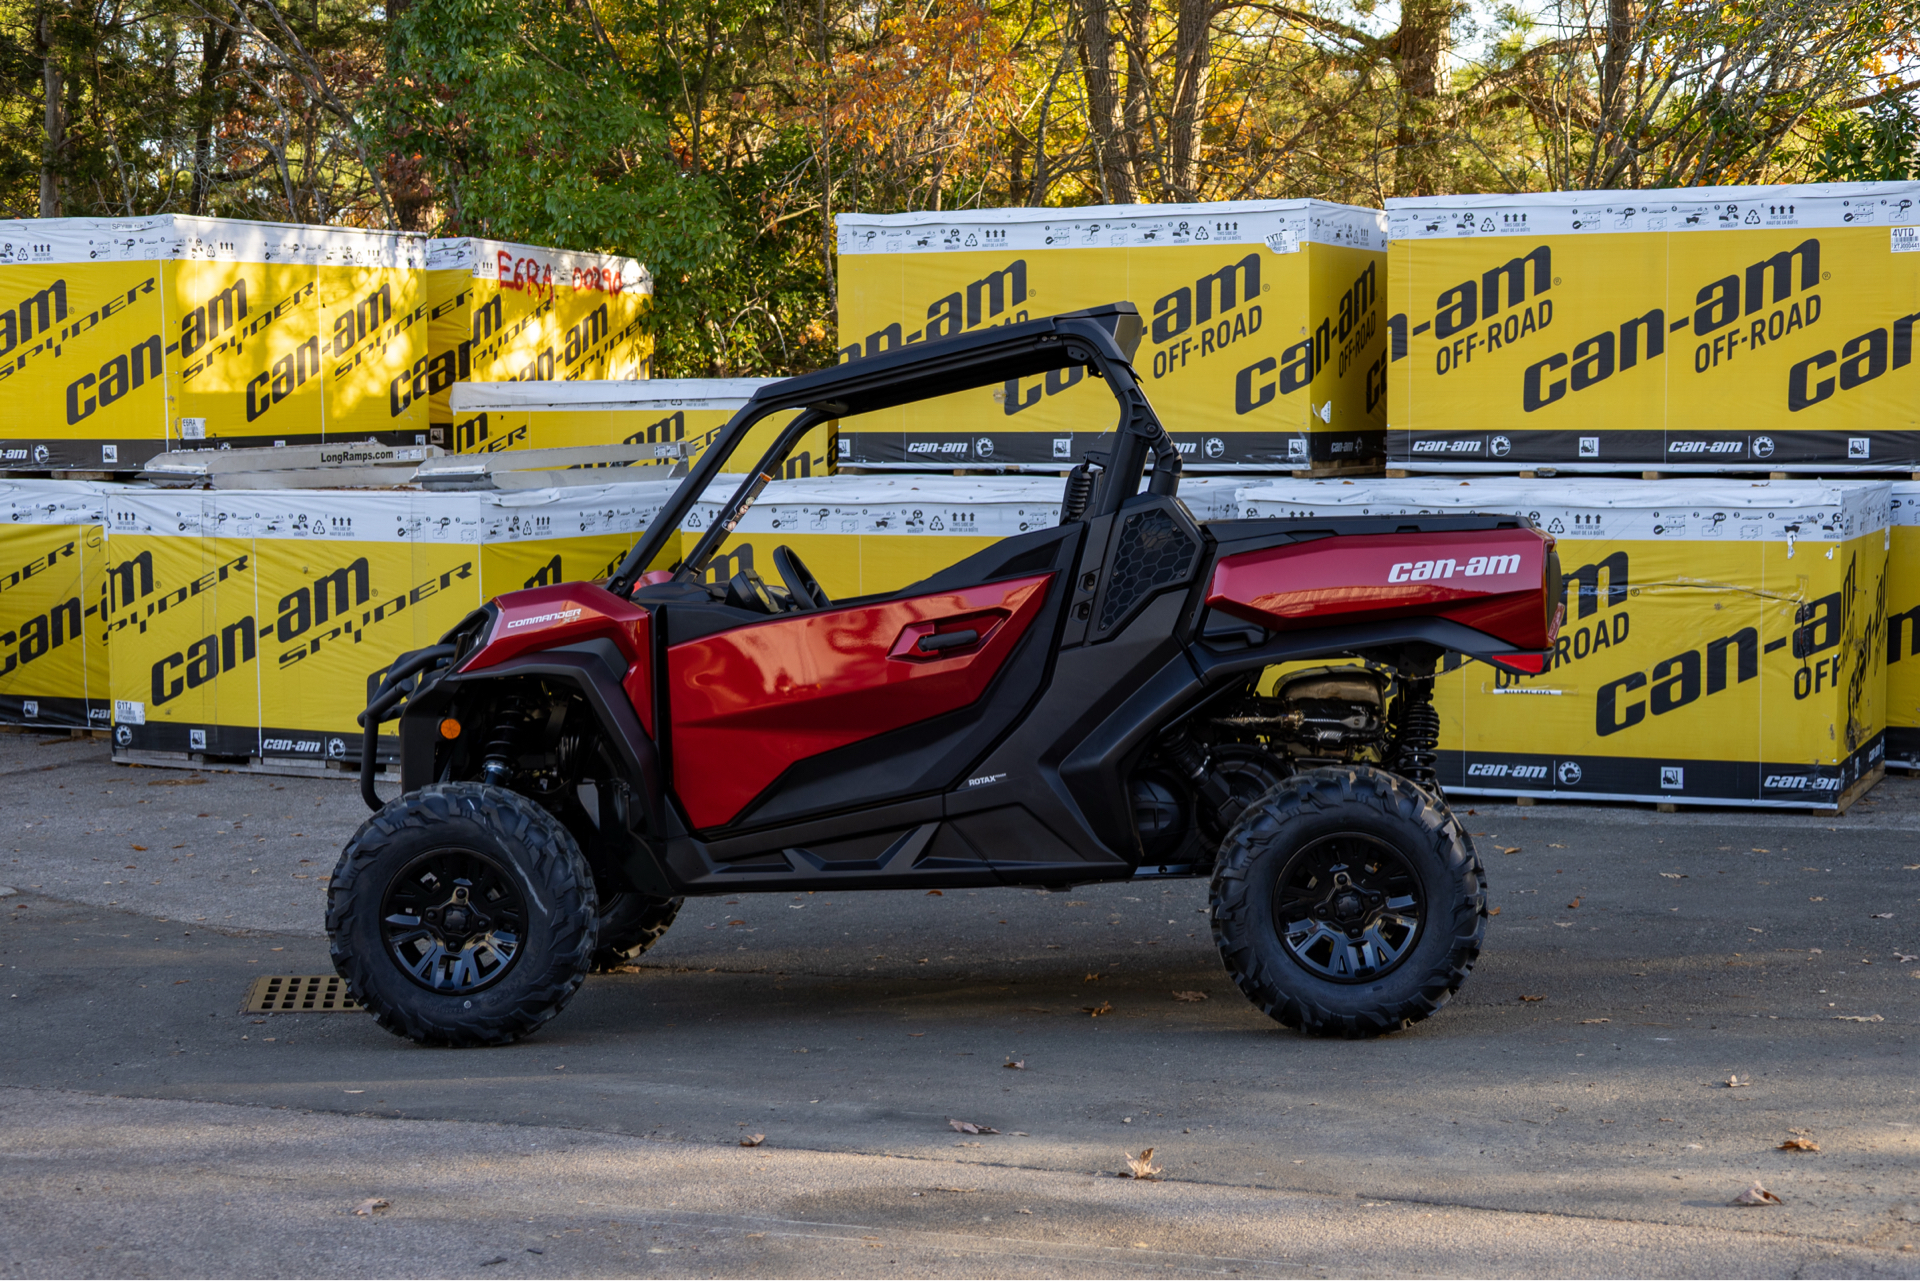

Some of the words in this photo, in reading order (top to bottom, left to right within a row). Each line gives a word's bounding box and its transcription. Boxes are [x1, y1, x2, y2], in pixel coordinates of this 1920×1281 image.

[1892, 228, 1915, 237] 4VTD
[183, 281, 314, 384] SPYDER
[1153, 305, 1262, 379] OFF-ROAD
[1235, 259, 1376, 416] can-am
[1338, 309, 1376, 379] OFF-ROAD
[1436, 299, 1553, 376] OFF-ROAD
[1522, 238, 1821, 412] can-am
[1694, 294, 1822, 374] OFF-ROAD
[66, 278, 248, 426] can-am
[246, 283, 392, 422] can-am
[320, 450, 394, 464] LongRamps.com
[908, 442, 968, 453] can-am
[1412, 440, 1482, 452] can-am
[1668, 441, 1743, 453] can-am
[1387, 554, 1521, 584] can-am
[151, 557, 370, 707] can-am
[279, 561, 472, 671] SPYDER
[507, 608, 581, 629] COMMANDER
[563, 615, 580, 625] XT
[263, 738, 321, 753] can-am
[968, 775, 996, 787] ROTAX
[1467, 763, 1548, 779] can-am
